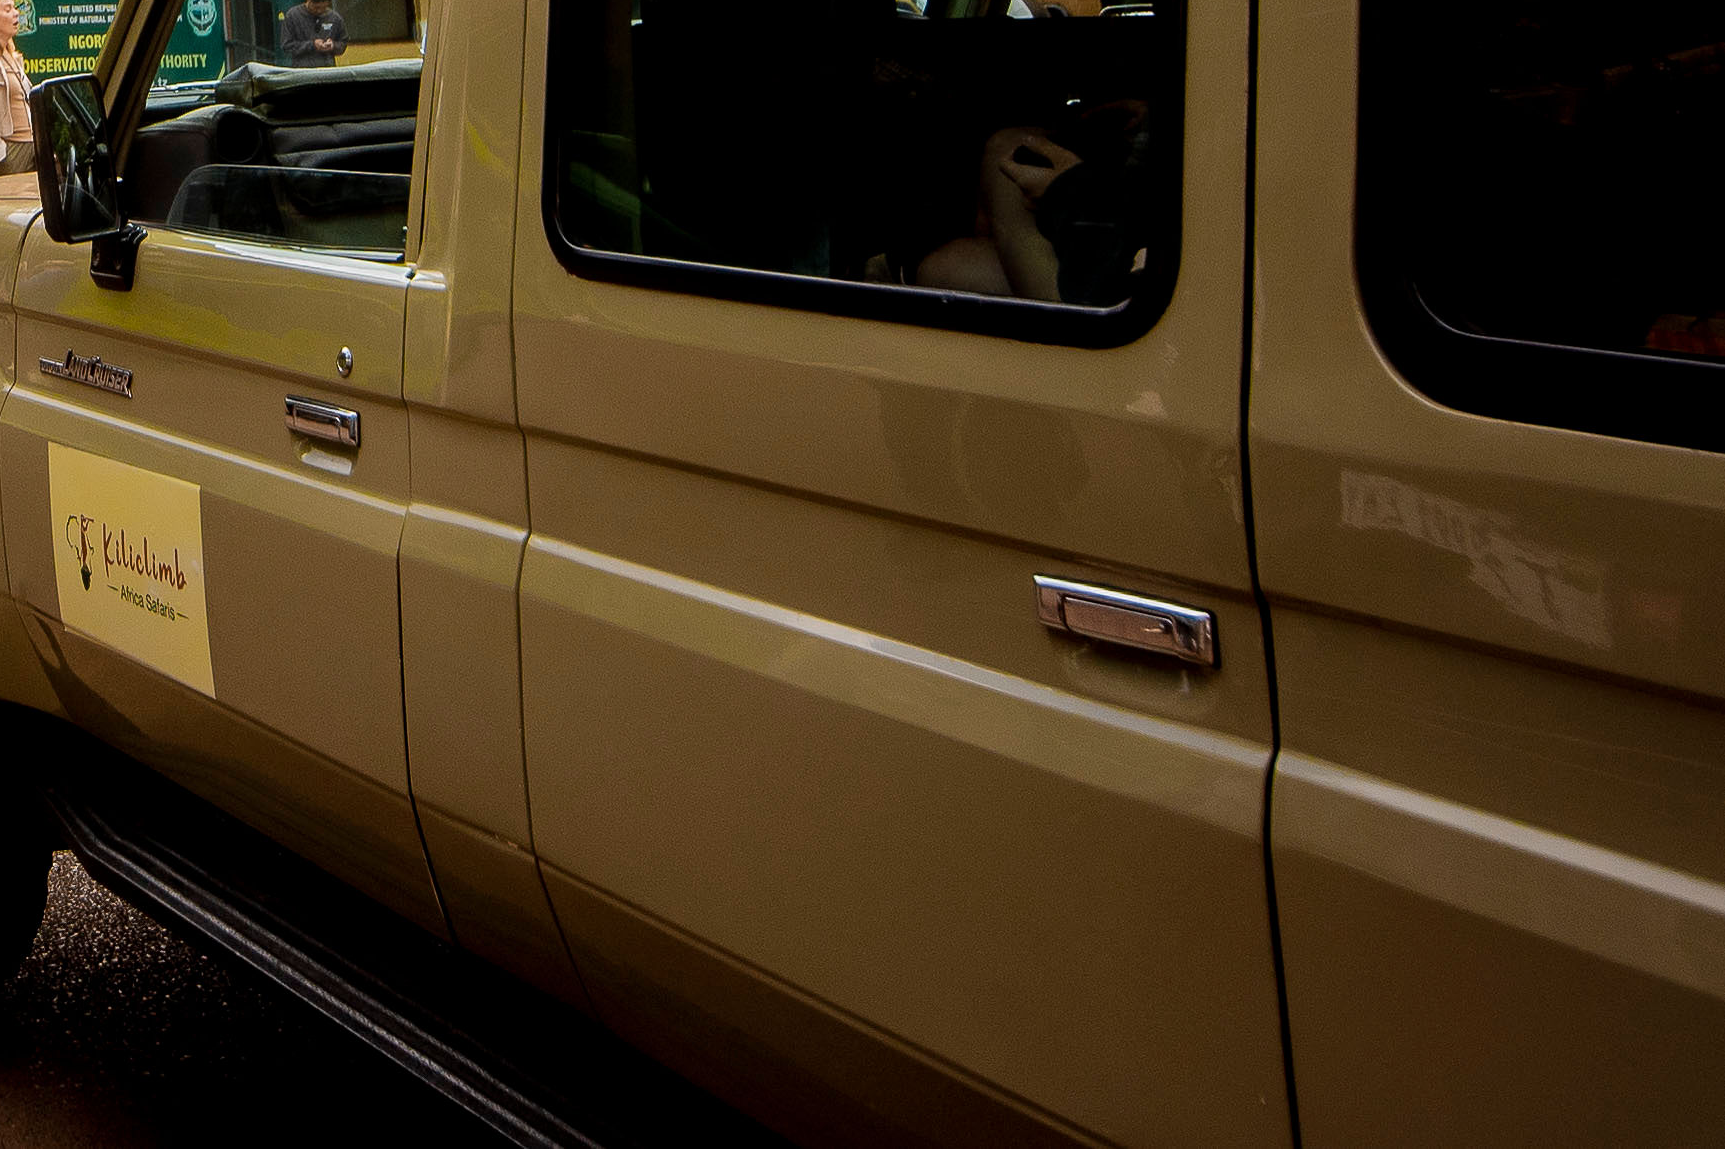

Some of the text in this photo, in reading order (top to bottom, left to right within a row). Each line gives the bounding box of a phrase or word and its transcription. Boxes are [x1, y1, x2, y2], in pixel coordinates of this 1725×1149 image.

[58, 4, 71, 15] THE
[72, 4, 94, 14] UNITED
[70, 15, 78, 25] OF
[23, 55, 99, 74] ONSERVATIO
[103, 522, 188, 591] Kiliclimb
[120, 585, 176, 621] Africa Safaris
